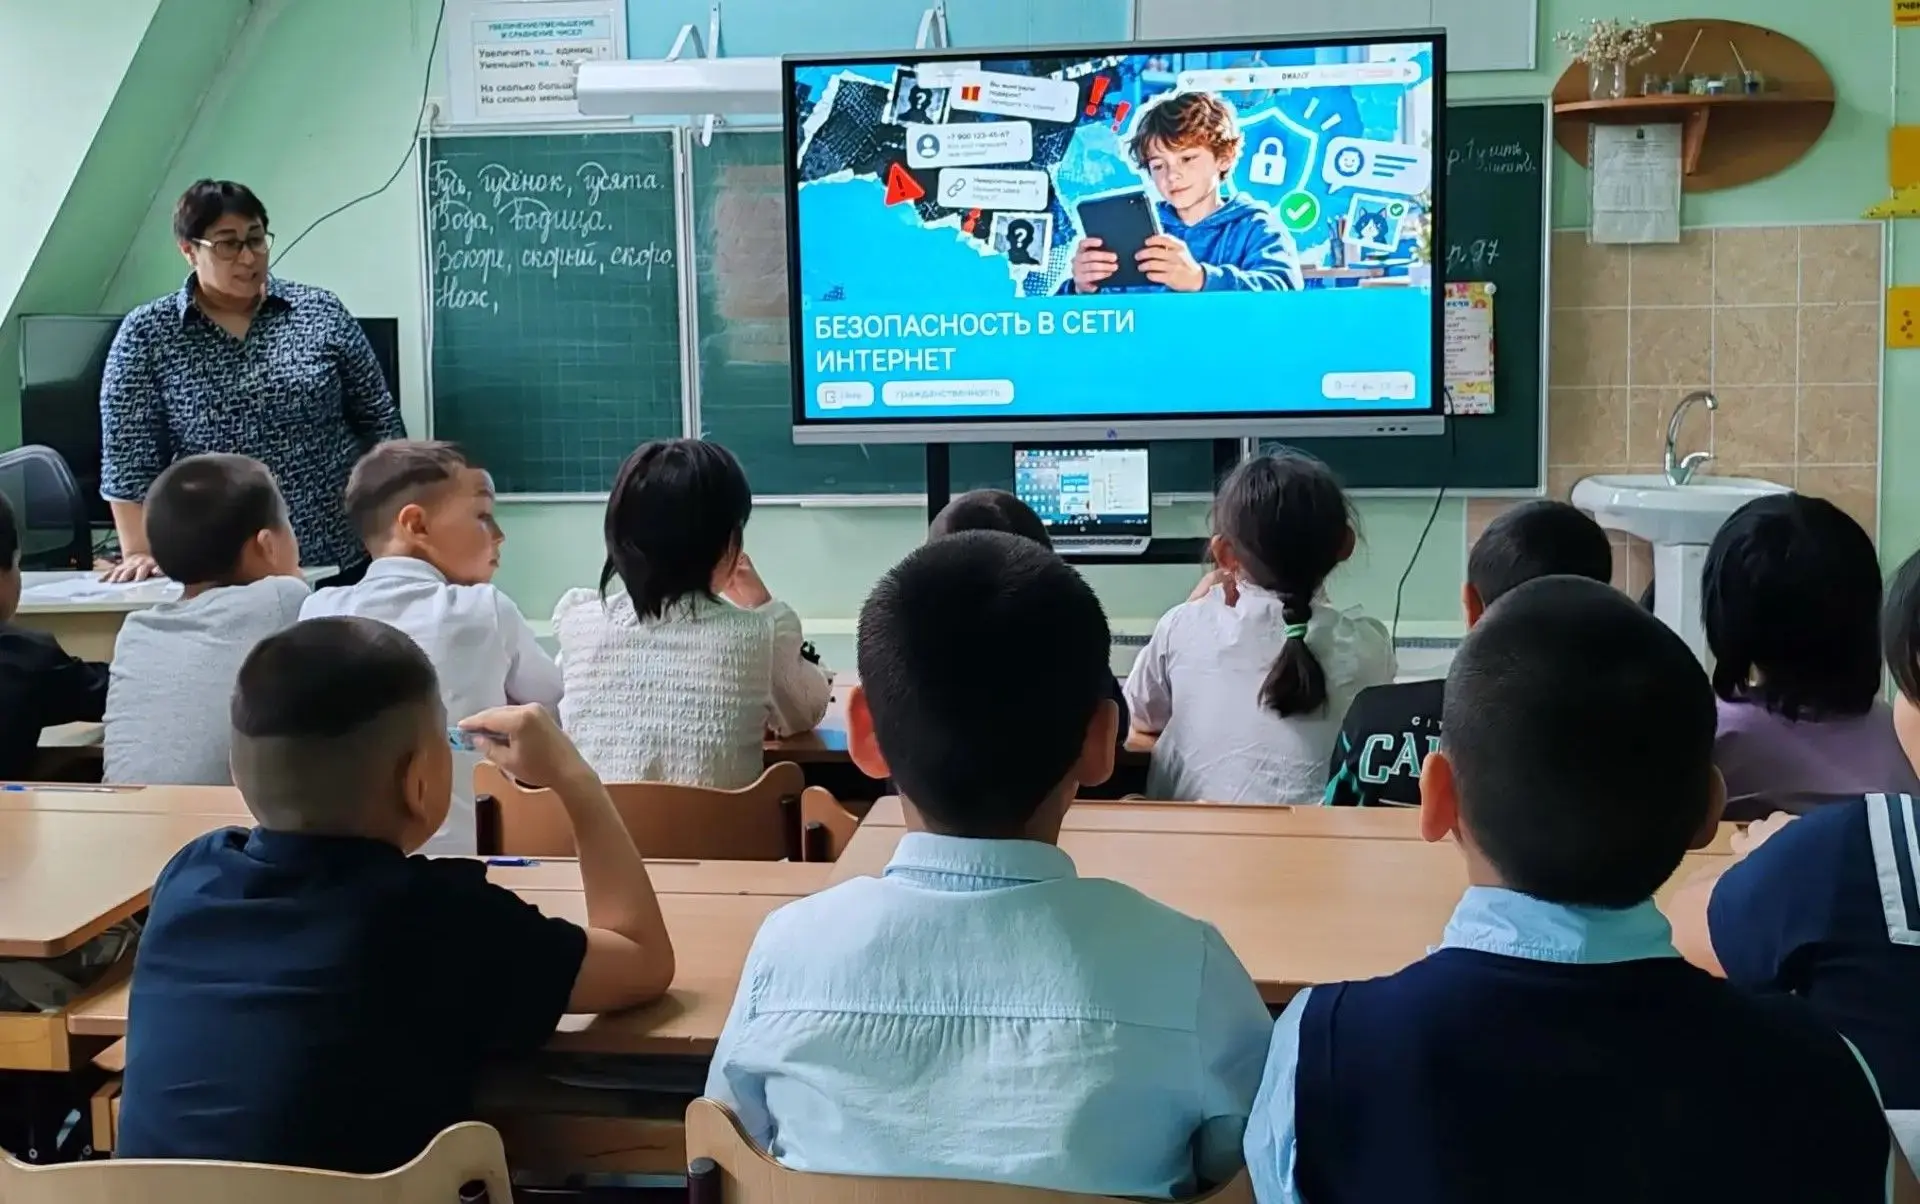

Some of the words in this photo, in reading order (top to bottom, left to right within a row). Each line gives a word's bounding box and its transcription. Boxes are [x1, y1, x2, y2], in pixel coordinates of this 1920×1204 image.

[539, 81, 575, 90] больш
[815, 311, 1031, 339] БЕЗОПАСНОСТЬ
[1037, 311, 1054, 334] В
[1062, 309, 1135, 334] СЕТИ
[816, 347, 957, 372] ИНТЕРНЕТ
